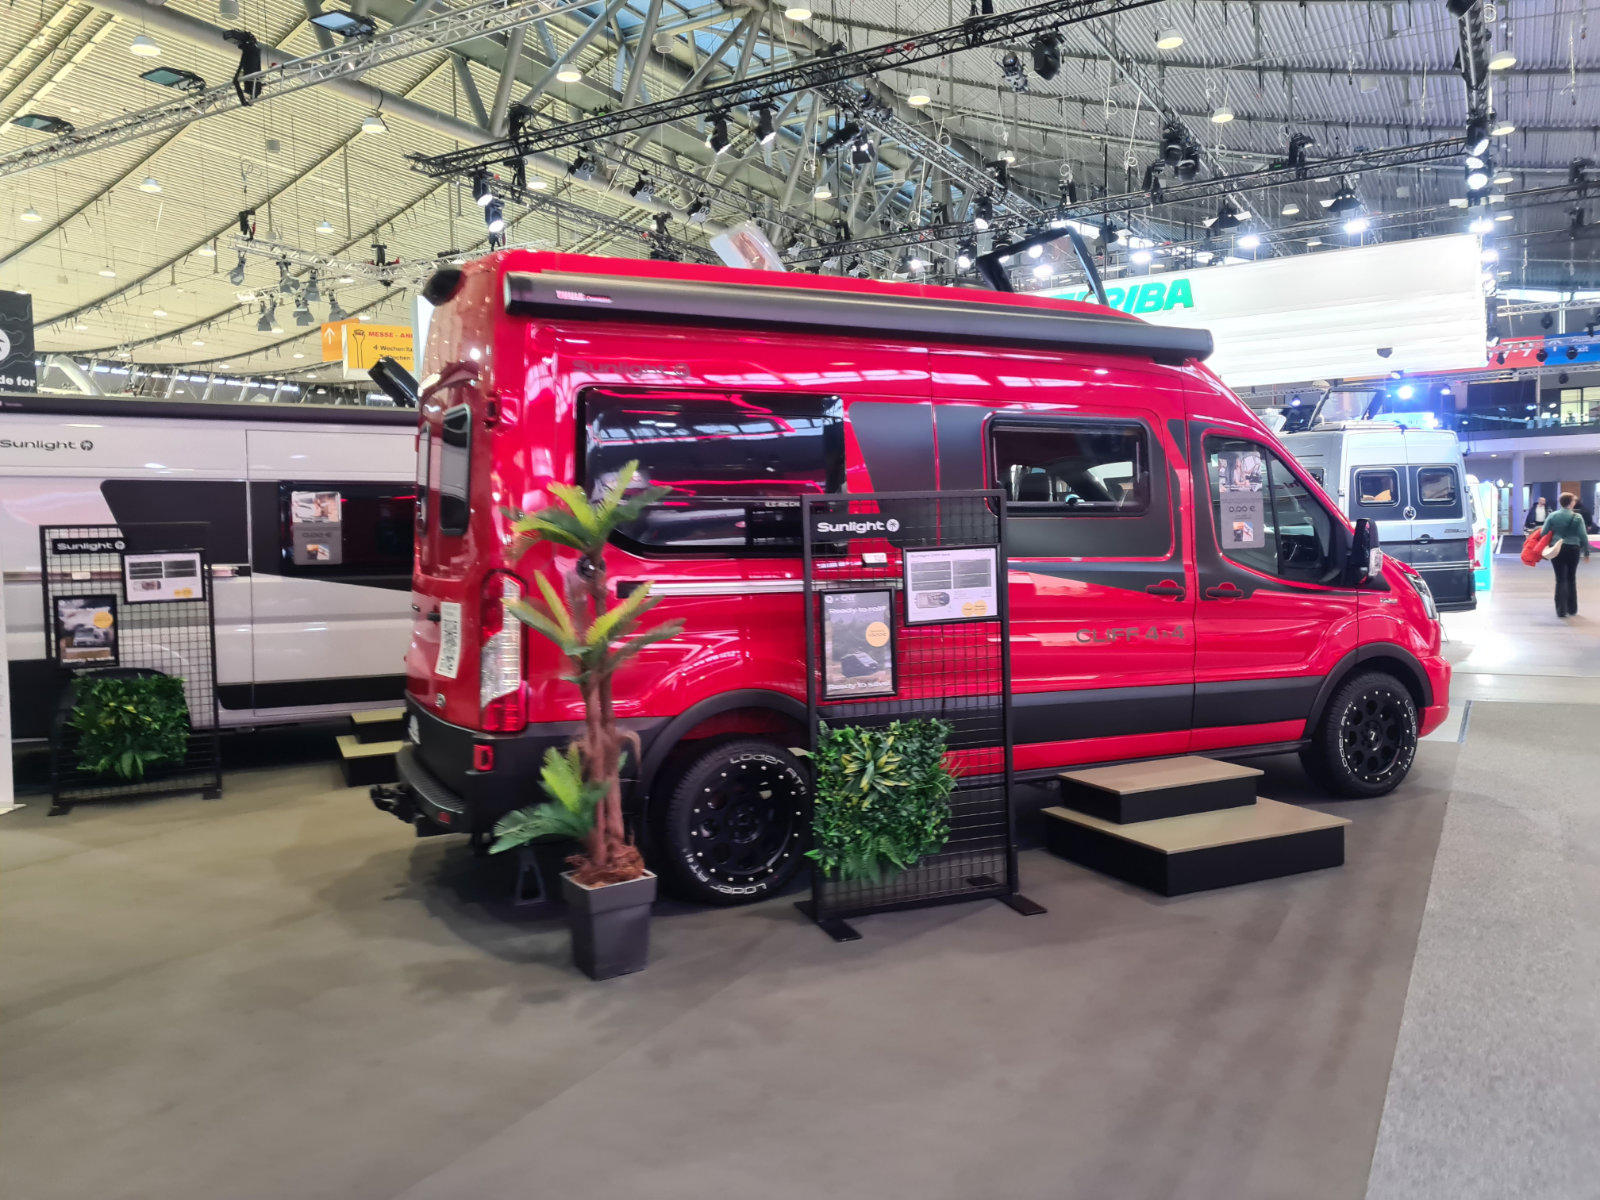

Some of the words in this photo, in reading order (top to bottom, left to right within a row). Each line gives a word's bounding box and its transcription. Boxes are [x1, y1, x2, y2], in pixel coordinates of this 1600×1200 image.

[571, 360, 666, 378] Sunlight
[16, 376, 36, 387] for
[0, 439, 77, 452] Sunlight
[817, 520, 886, 534] Sunlight
[57, 541, 114, 552] Sunlight
[1076, 627, 1139, 643] CLIFF
